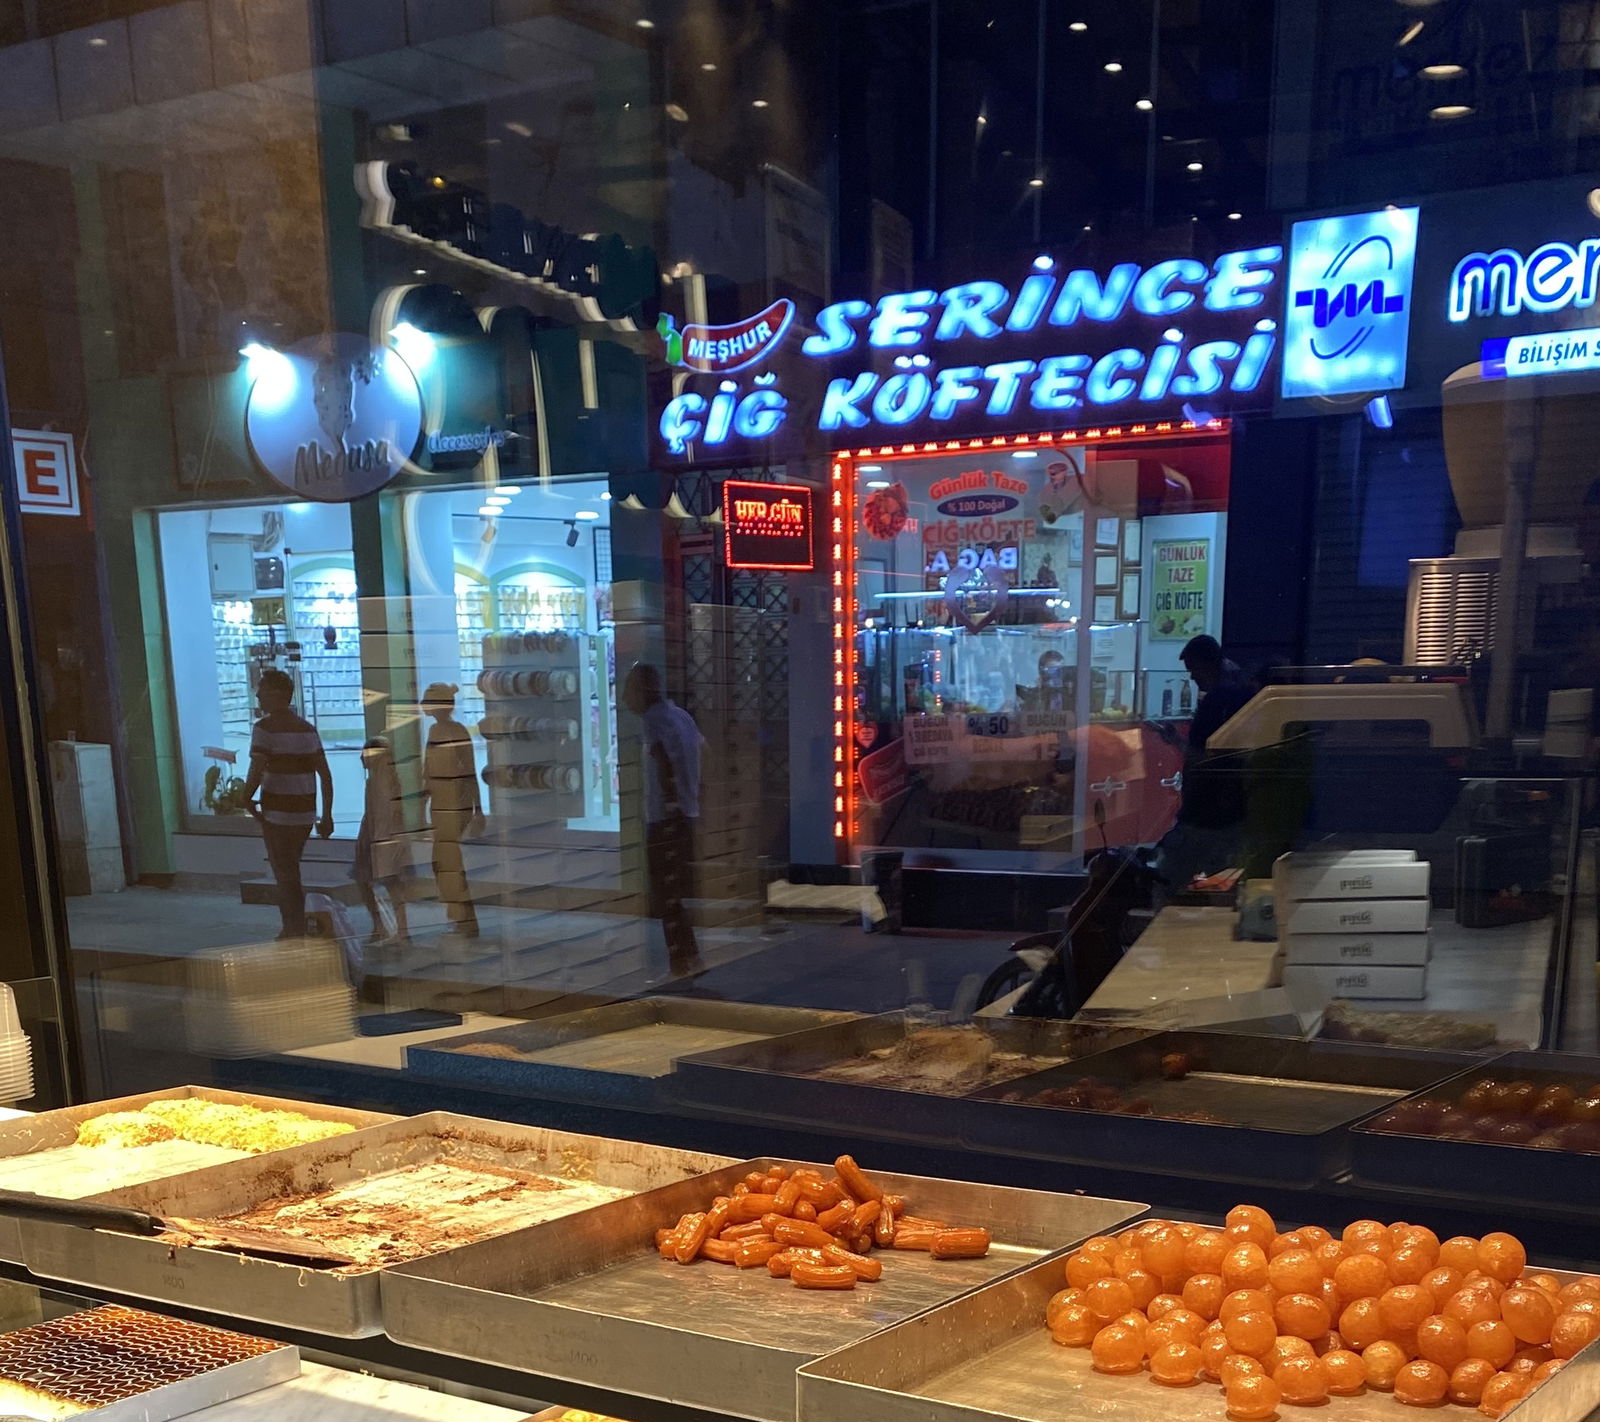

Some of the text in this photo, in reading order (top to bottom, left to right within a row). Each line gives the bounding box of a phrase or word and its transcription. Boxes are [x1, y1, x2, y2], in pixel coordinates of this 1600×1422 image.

[801, 245, 1283, 357] SERİNCE
[687, 320, 772, 363] MEŞHUR
[1518, 338, 1588, 366] BİLİŞİM
[660, 318, 1278, 454] ÇİĞ KÖFTECİSİ
[23, 449, 59, 496] E
[929, 470, 1029, 499] Günlük Taze
[959, 500, 976, 512] 100
[977, 498, 1006, 513] Doğal
[964, 515, 1037, 543] KÖFTE
[1159, 543, 1206, 562] GÜNLÜK
[1167, 566, 1195, 584] TAZE
[1174, 586, 1203, 611] KÖFTE
[988, 716, 1009, 736] 50
